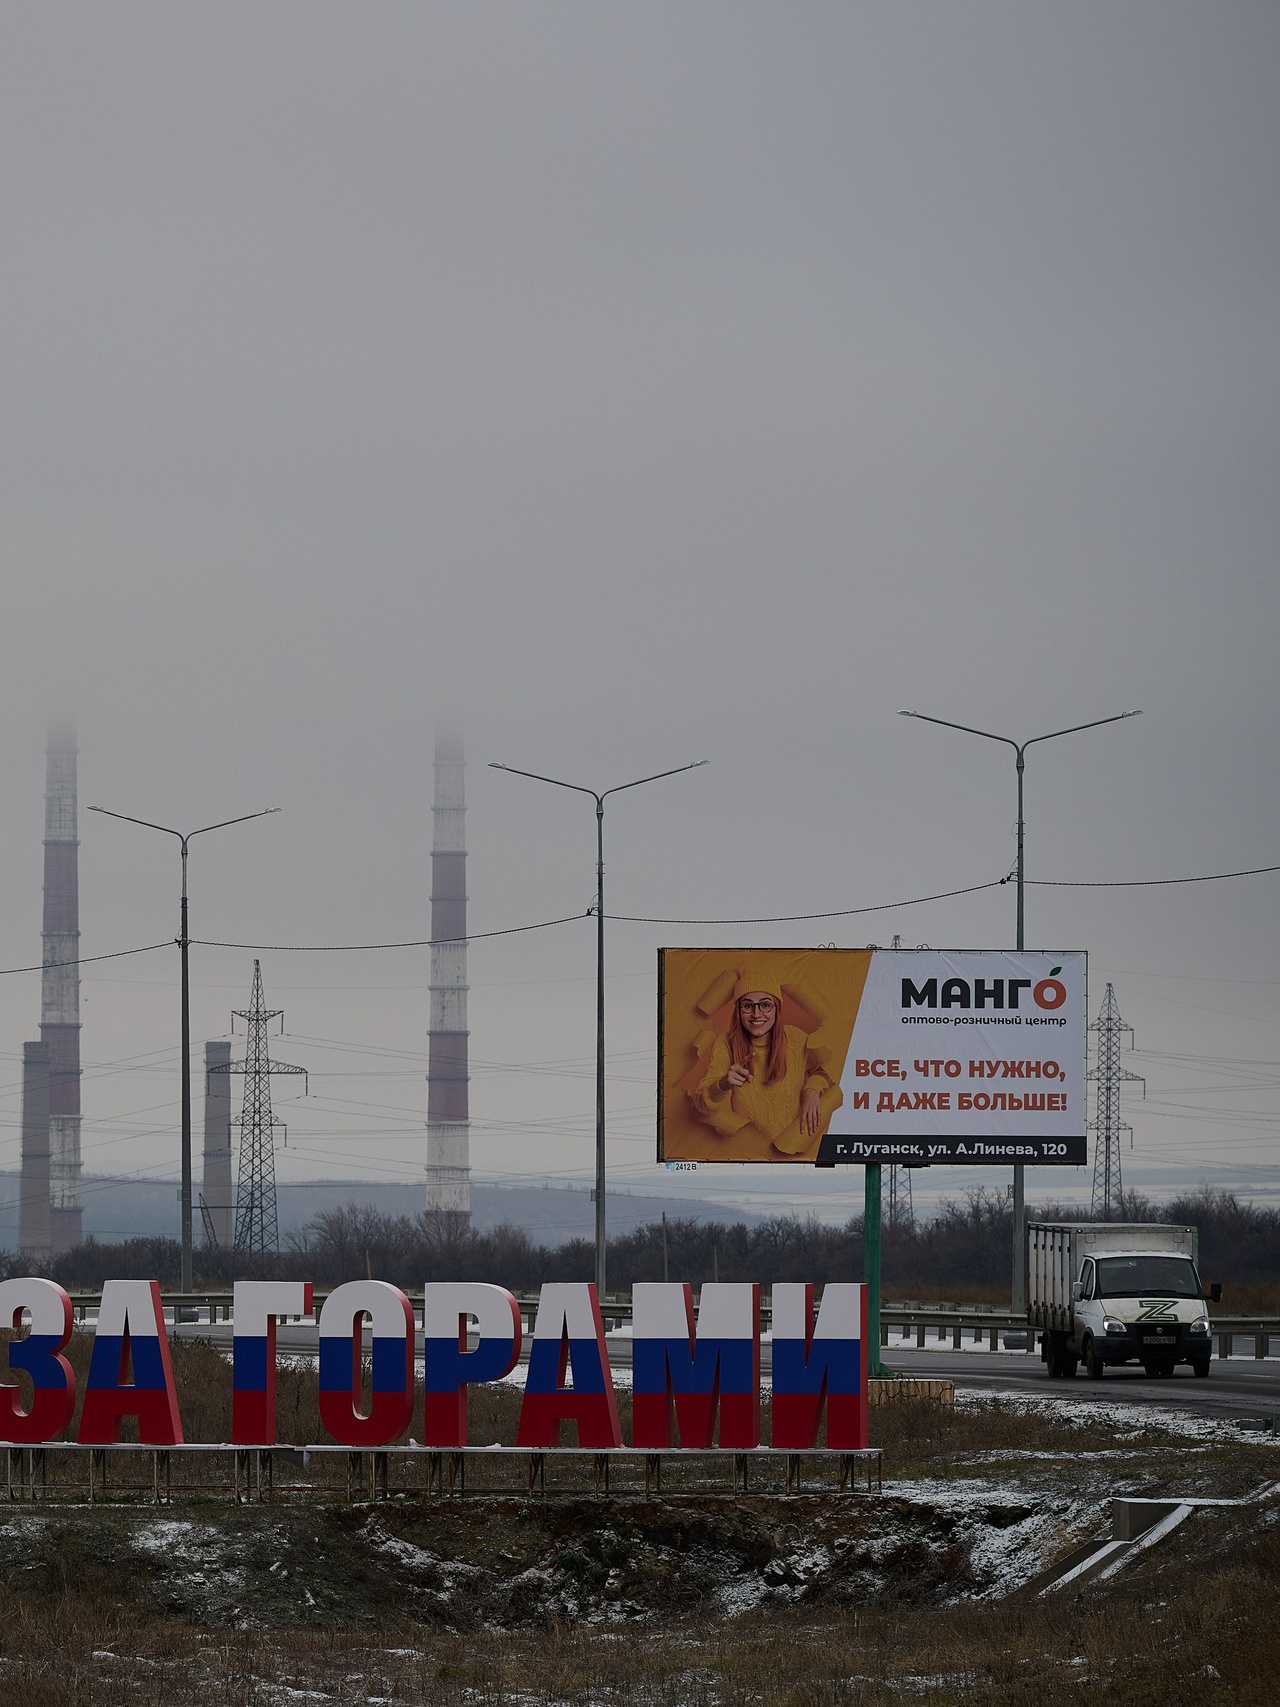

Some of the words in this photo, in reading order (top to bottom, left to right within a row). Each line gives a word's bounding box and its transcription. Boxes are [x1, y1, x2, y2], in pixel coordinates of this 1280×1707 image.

[901, 972, 1067, 1010] МАНГО
[901, 1015, 1022, 1027] оптово-розничный
[1025, 1017, 1067, 1028] центр
[855, 1058, 908, 1082] ВСЕ,
[913, 1059, 962, 1079] ЧТО
[968, 1059, 1066, 1083] НУЖНО,
[853, 1091, 870, 1110] И
[876, 1091, 951, 1114] ДАЖЕ
[957, 1092, 1068, 1112] БОЛЬШЕ!
[836, 1144, 848, 1154] г.
[851, 1142, 924, 1157] Луганск,
[927, 1144, 952, 1158] ул.
[1041, 1143, 1068, 1156] 120
[1135, 1300, 1179, 1322] Z
[233, 1279, 869, 1449] ГОРАМИ
